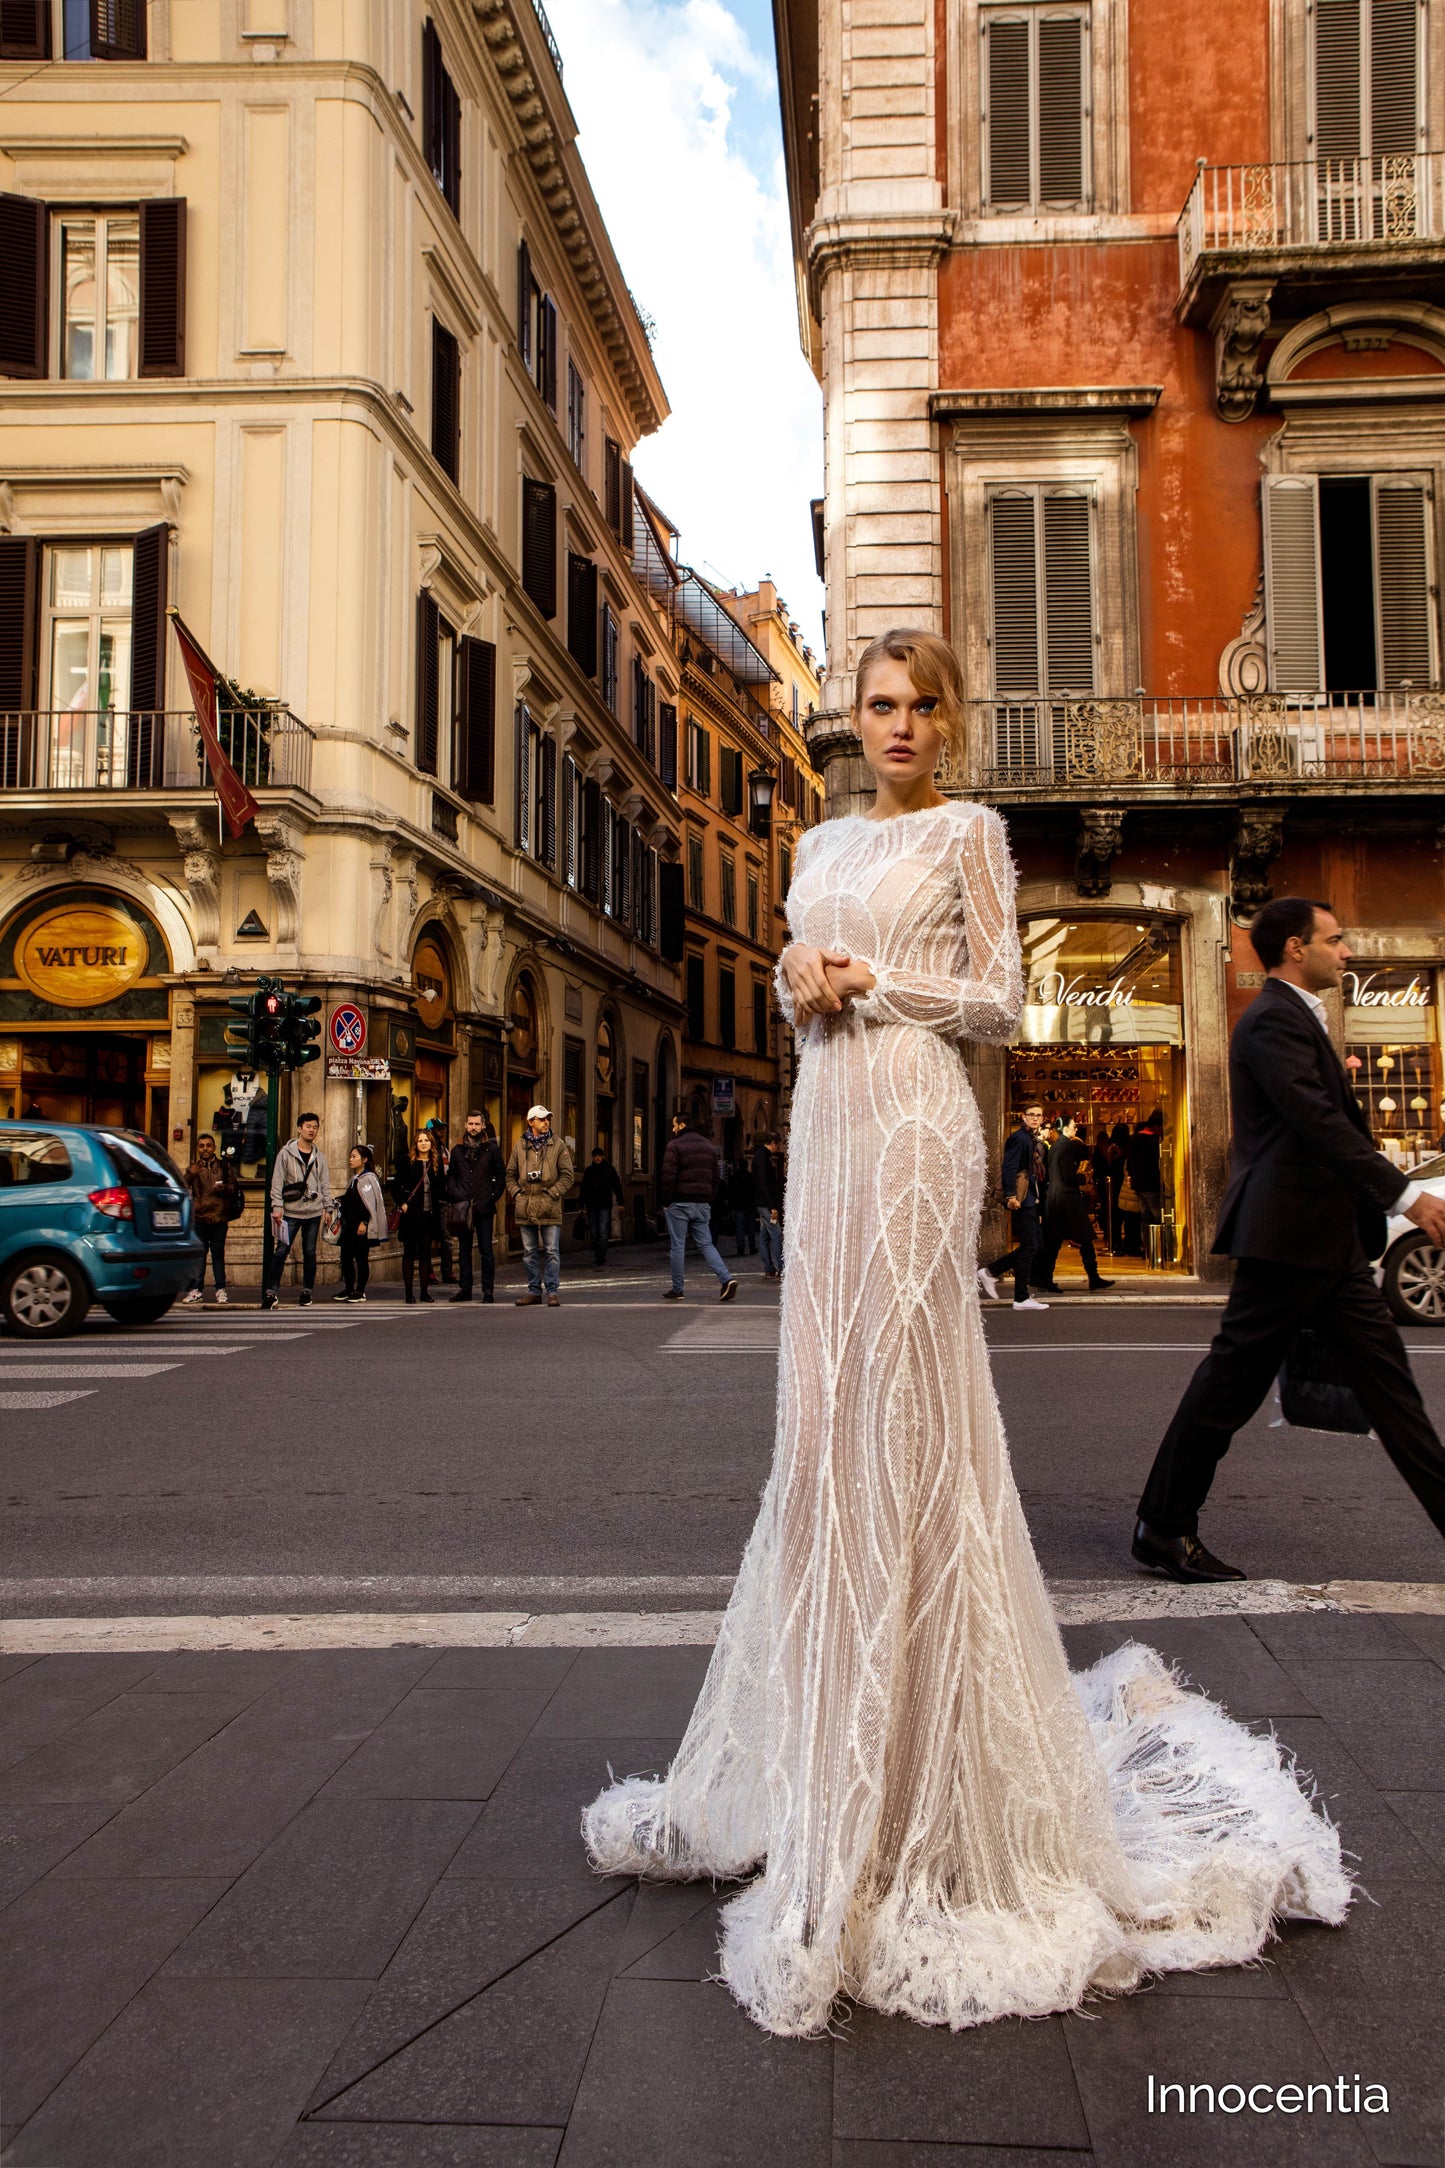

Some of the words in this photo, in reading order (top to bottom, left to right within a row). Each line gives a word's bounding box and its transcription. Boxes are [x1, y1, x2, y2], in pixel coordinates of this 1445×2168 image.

[36, 946, 127, 966] VATURI
[1039, 972, 1136, 1006] Venchi
[1342, 972, 1430, 1006] Venchi
